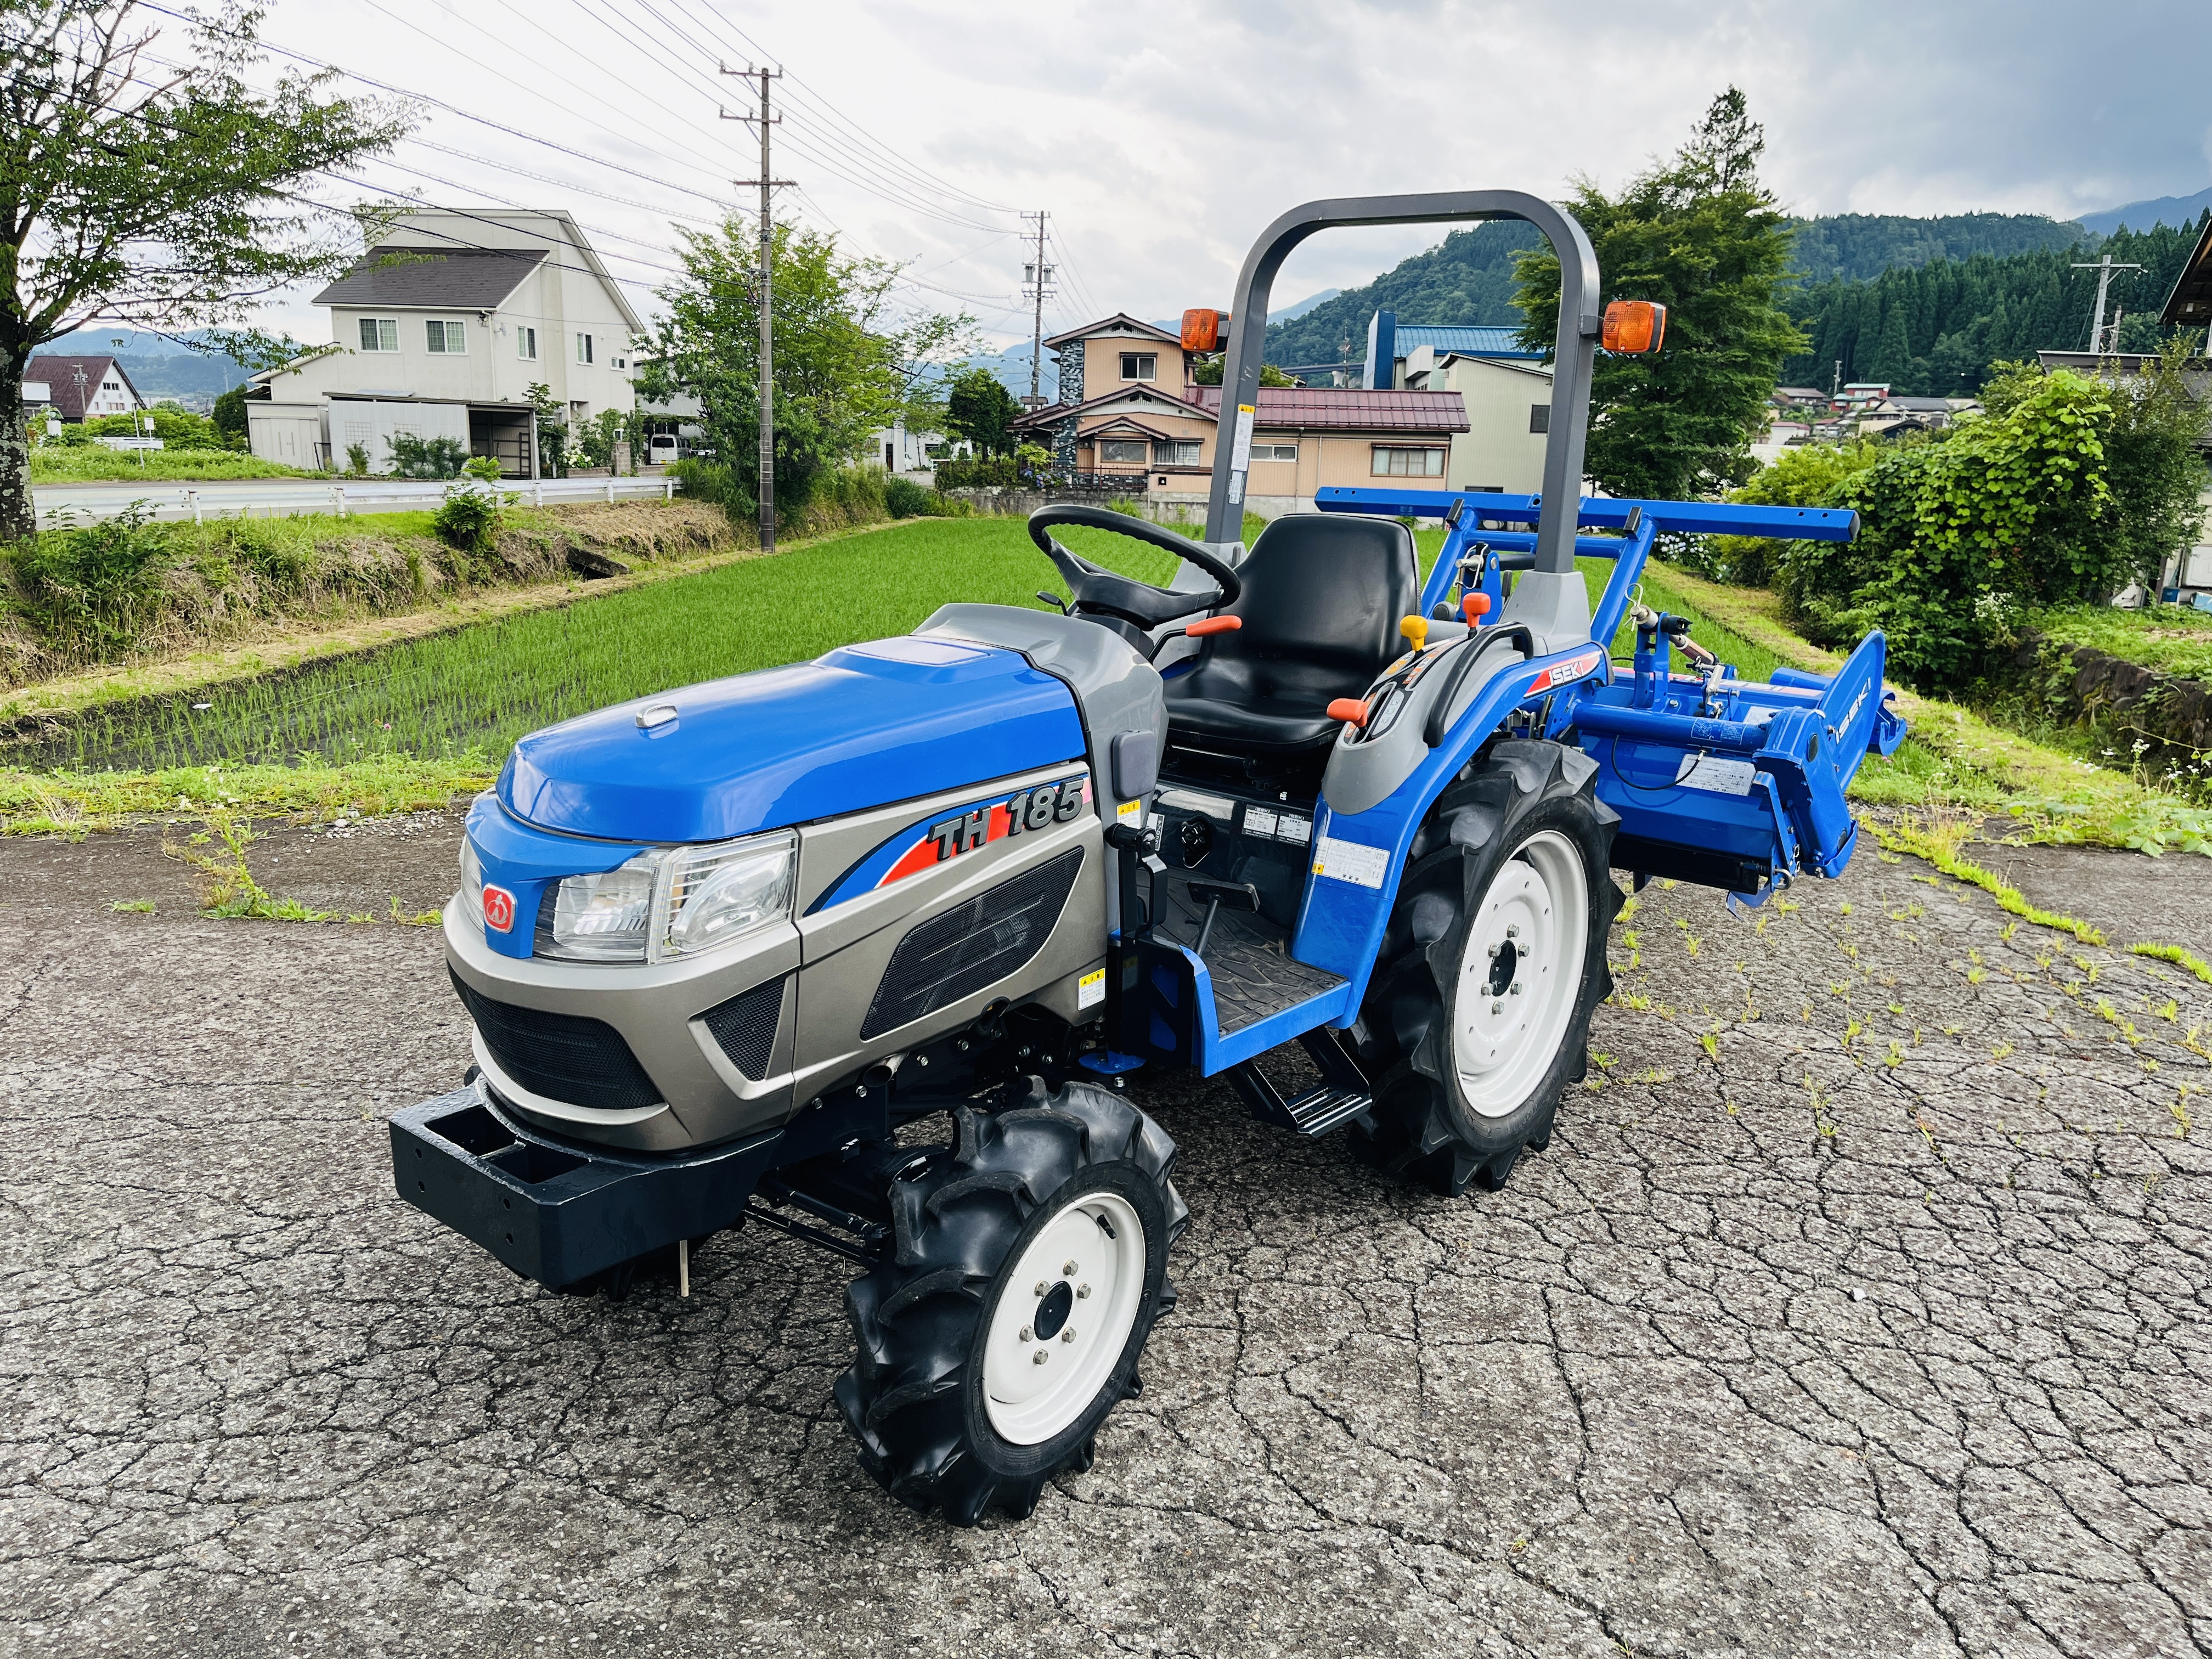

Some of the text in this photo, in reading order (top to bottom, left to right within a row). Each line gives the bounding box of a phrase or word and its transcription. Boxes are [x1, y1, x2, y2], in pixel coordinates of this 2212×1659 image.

[1548, 661, 1584, 686] ISEKI
[1835, 676, 1871, 745] ISEKI
[927, 778, 1084, 861] TH 185
